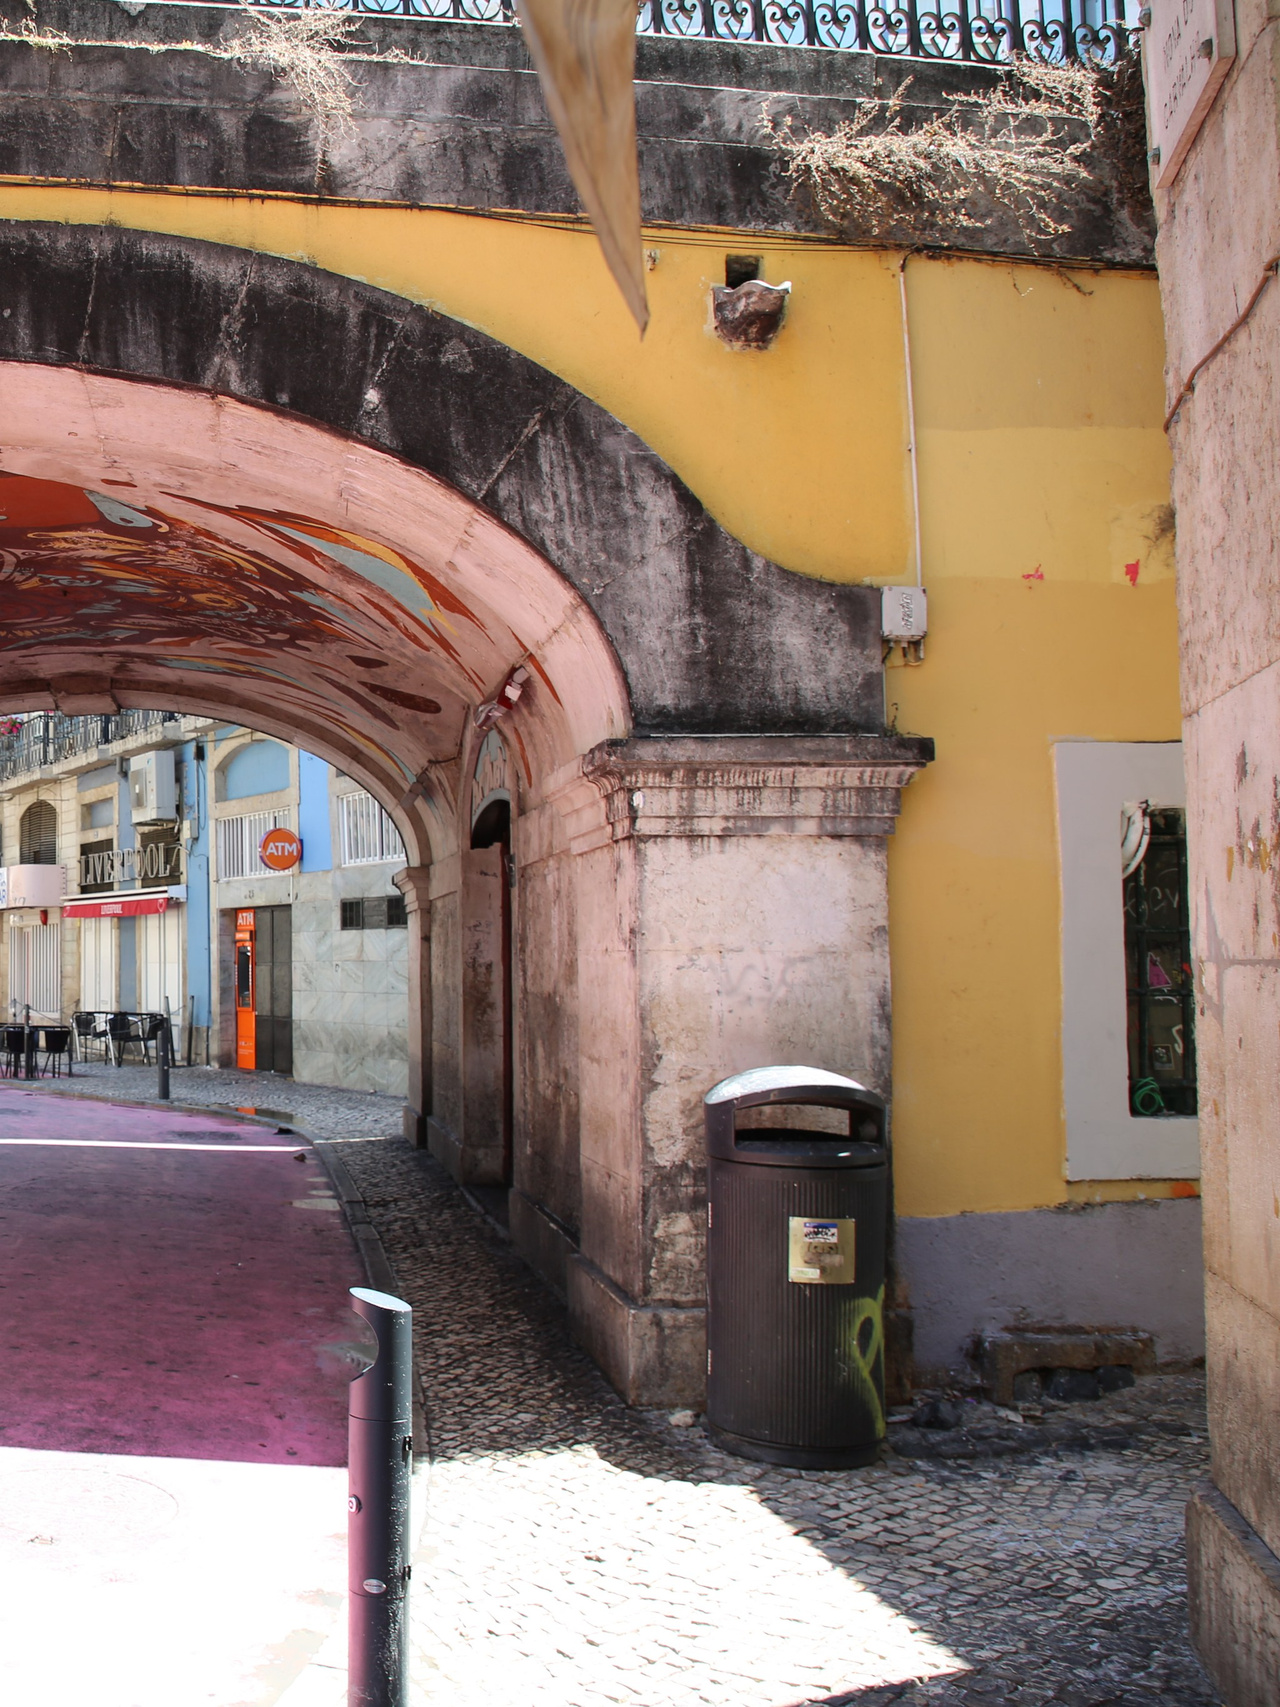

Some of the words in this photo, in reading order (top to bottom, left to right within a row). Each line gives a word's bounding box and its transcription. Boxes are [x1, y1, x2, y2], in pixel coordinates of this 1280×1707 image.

[266, 842, 298, 856] ATM
[79, 842, 171, 887] LIVERPOOL
[237, 912, 254, 926] ATM
